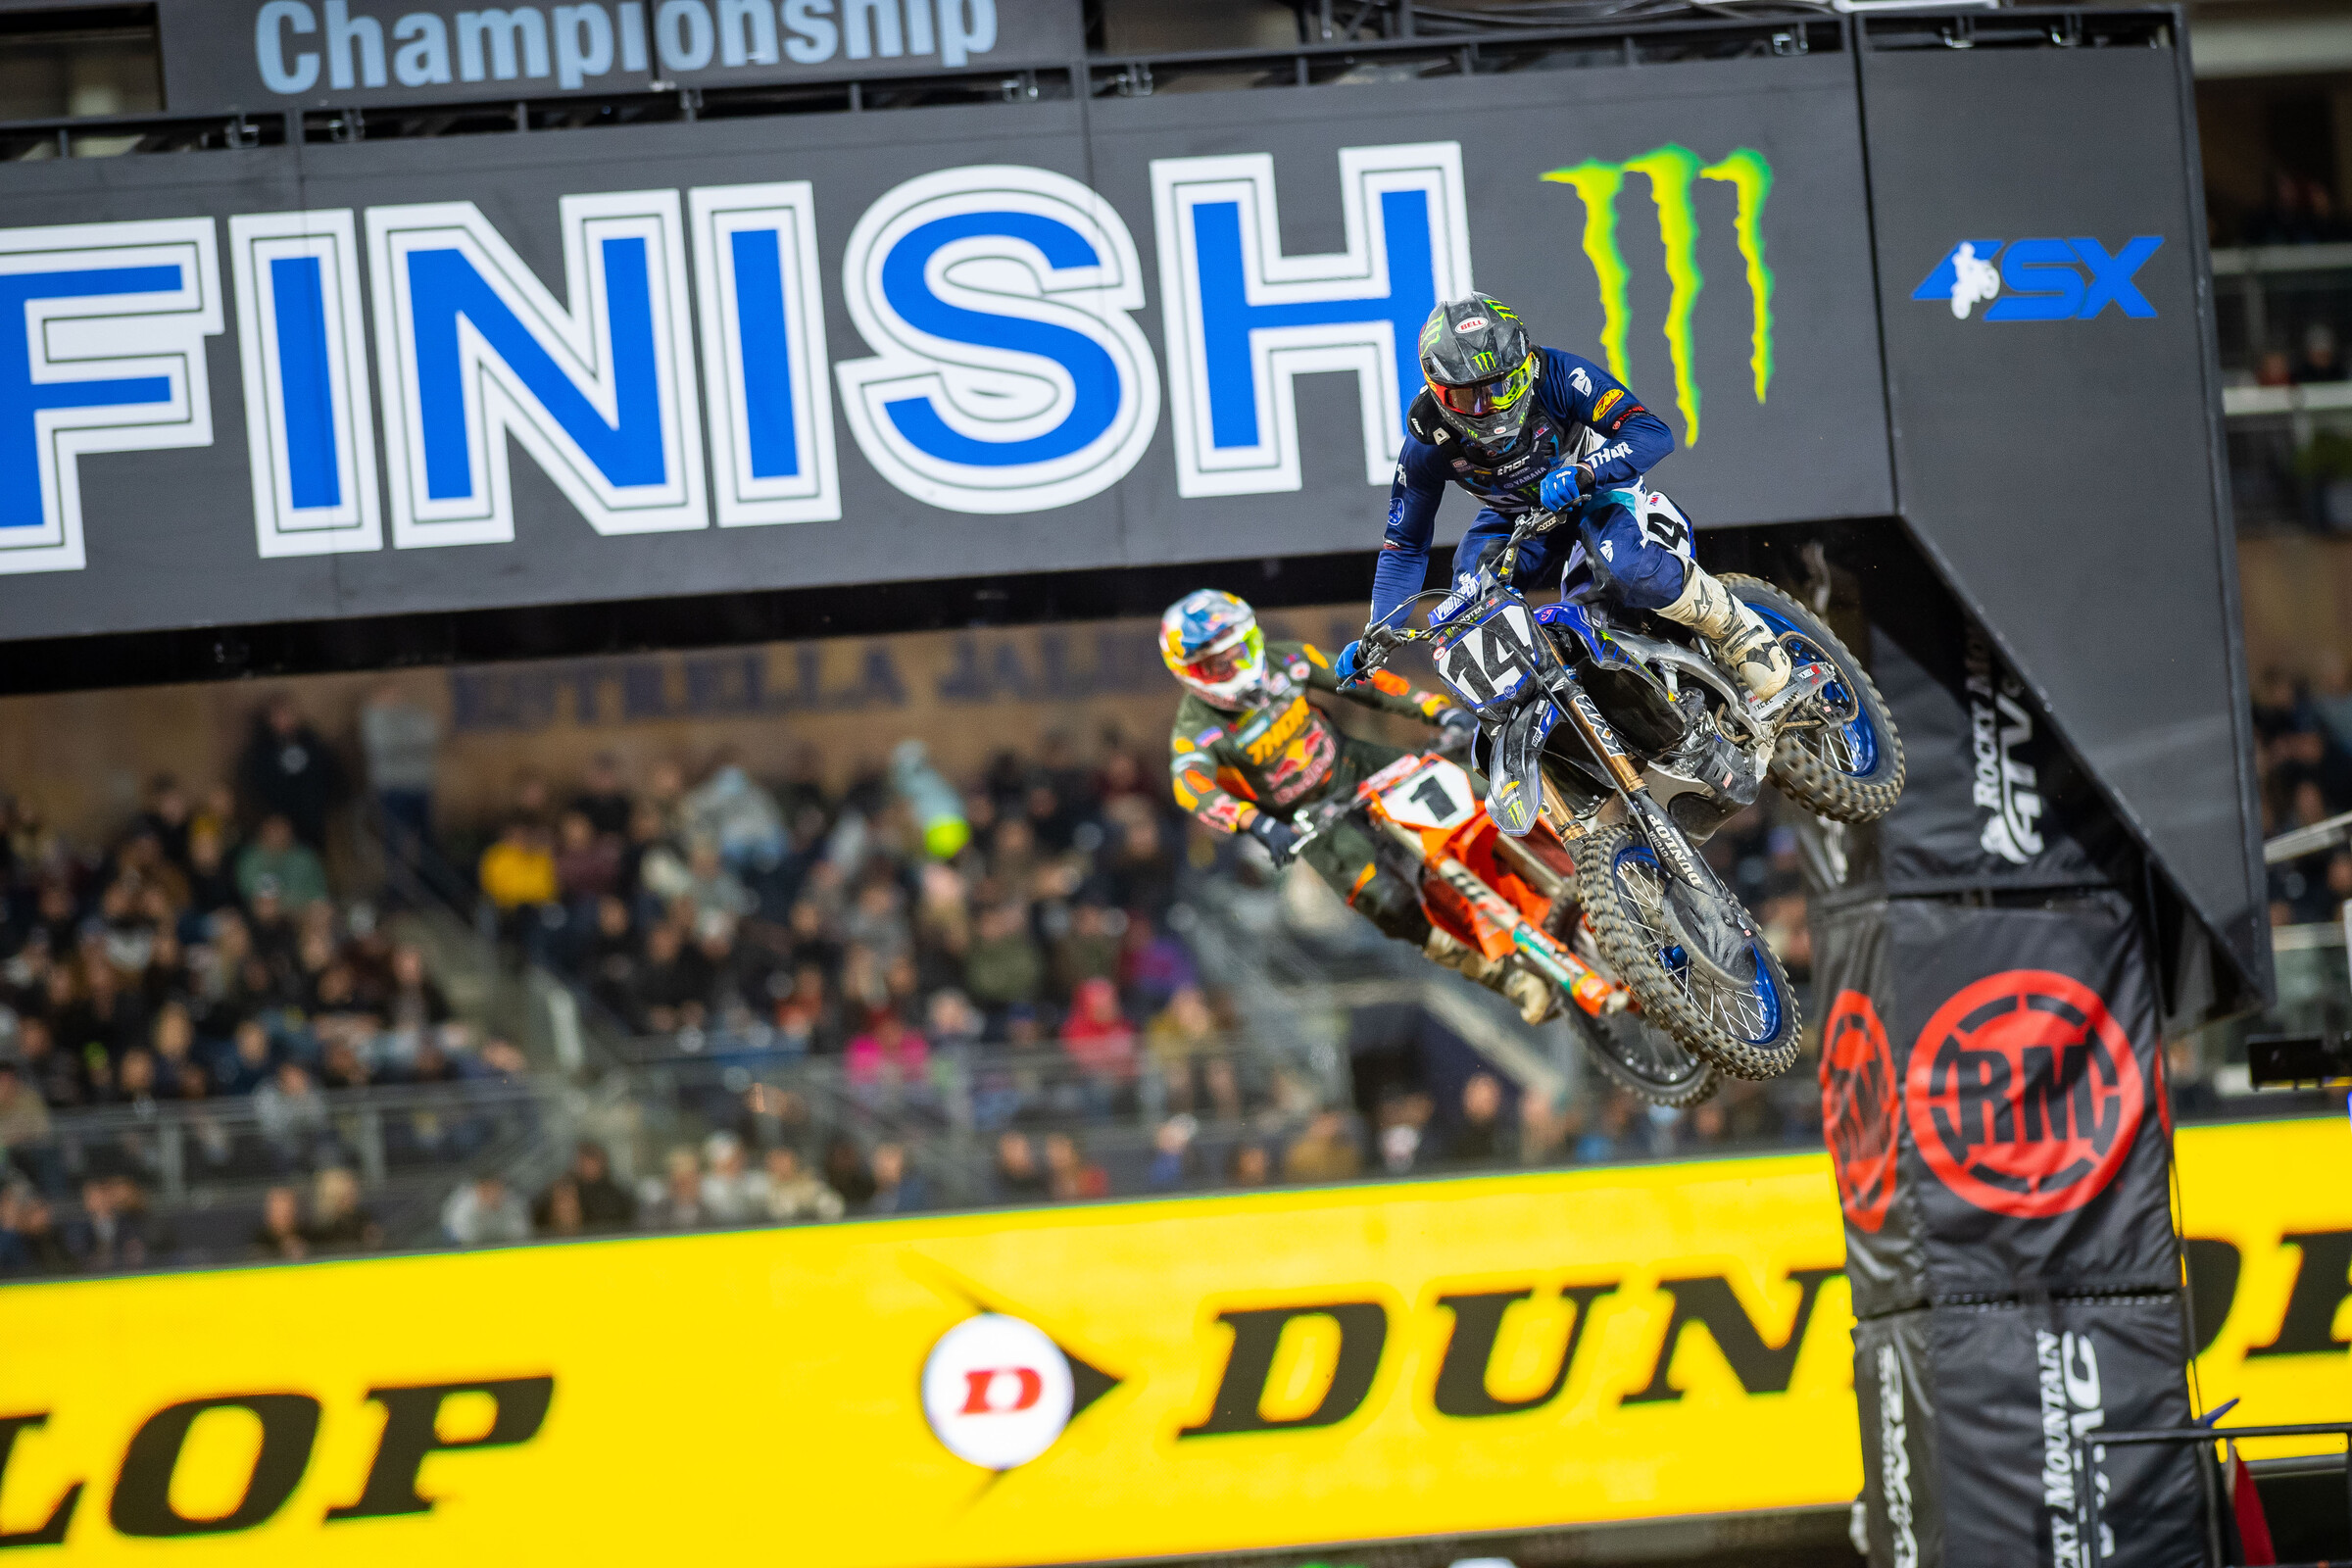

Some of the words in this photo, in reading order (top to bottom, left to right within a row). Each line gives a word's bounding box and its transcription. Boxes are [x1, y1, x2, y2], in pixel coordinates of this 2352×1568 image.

[255, 0, 1000, 95] Championship
[1460, 319, 1484, 331] BELL
[0, 140, 1474, 576] FINISH
[1497, 455, 1531, 476] thor
[1513, 466, 1547, 486] YAMAHA
[1585, 441, 1634, 469] THOR
[1451, 605, 1485, 631] MNSTER
[1447, 612, 1535, 703] 14
[1972, 699, 2001, 811] ROCKY
[1409, 774, 1458, 822] 1
[1647, 814, 1703, 888] DUNLOP
[1648, 830, 1669, 858] CYCRA
[1959, 1039, 2091, 1145] RM
[1179, 1264, 1848, 1441] DUN
[956, 1366, 1045, 1417] D
[2035, 1328, 2077, 1515] MOUNTAIN
